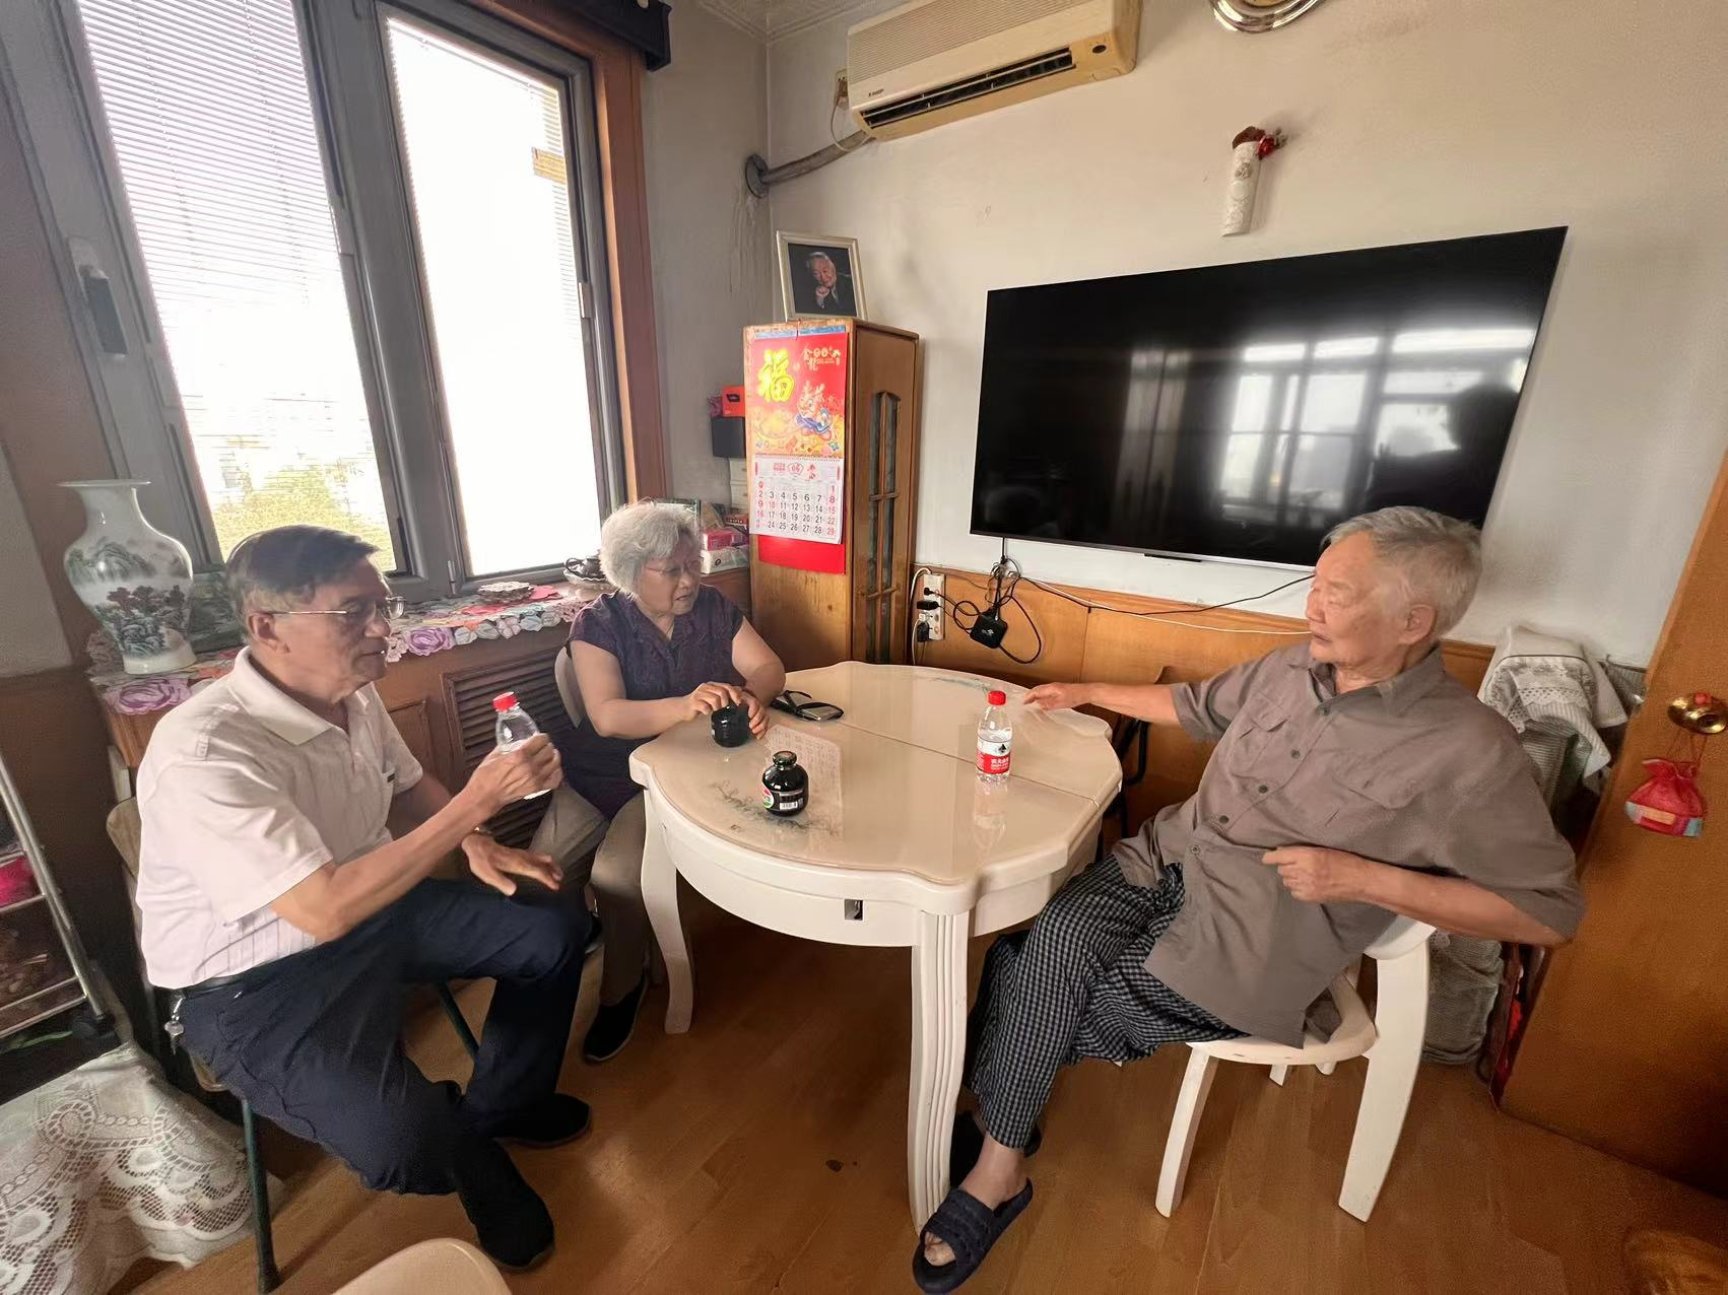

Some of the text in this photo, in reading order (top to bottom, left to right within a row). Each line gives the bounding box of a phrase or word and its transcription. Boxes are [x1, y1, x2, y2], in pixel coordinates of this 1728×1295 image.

[758, 348, 795, 402] 福
[770, 490, 774, 498] 3
[804, 504, 810, 512] 13
[790, 523, 798, 531] 26
